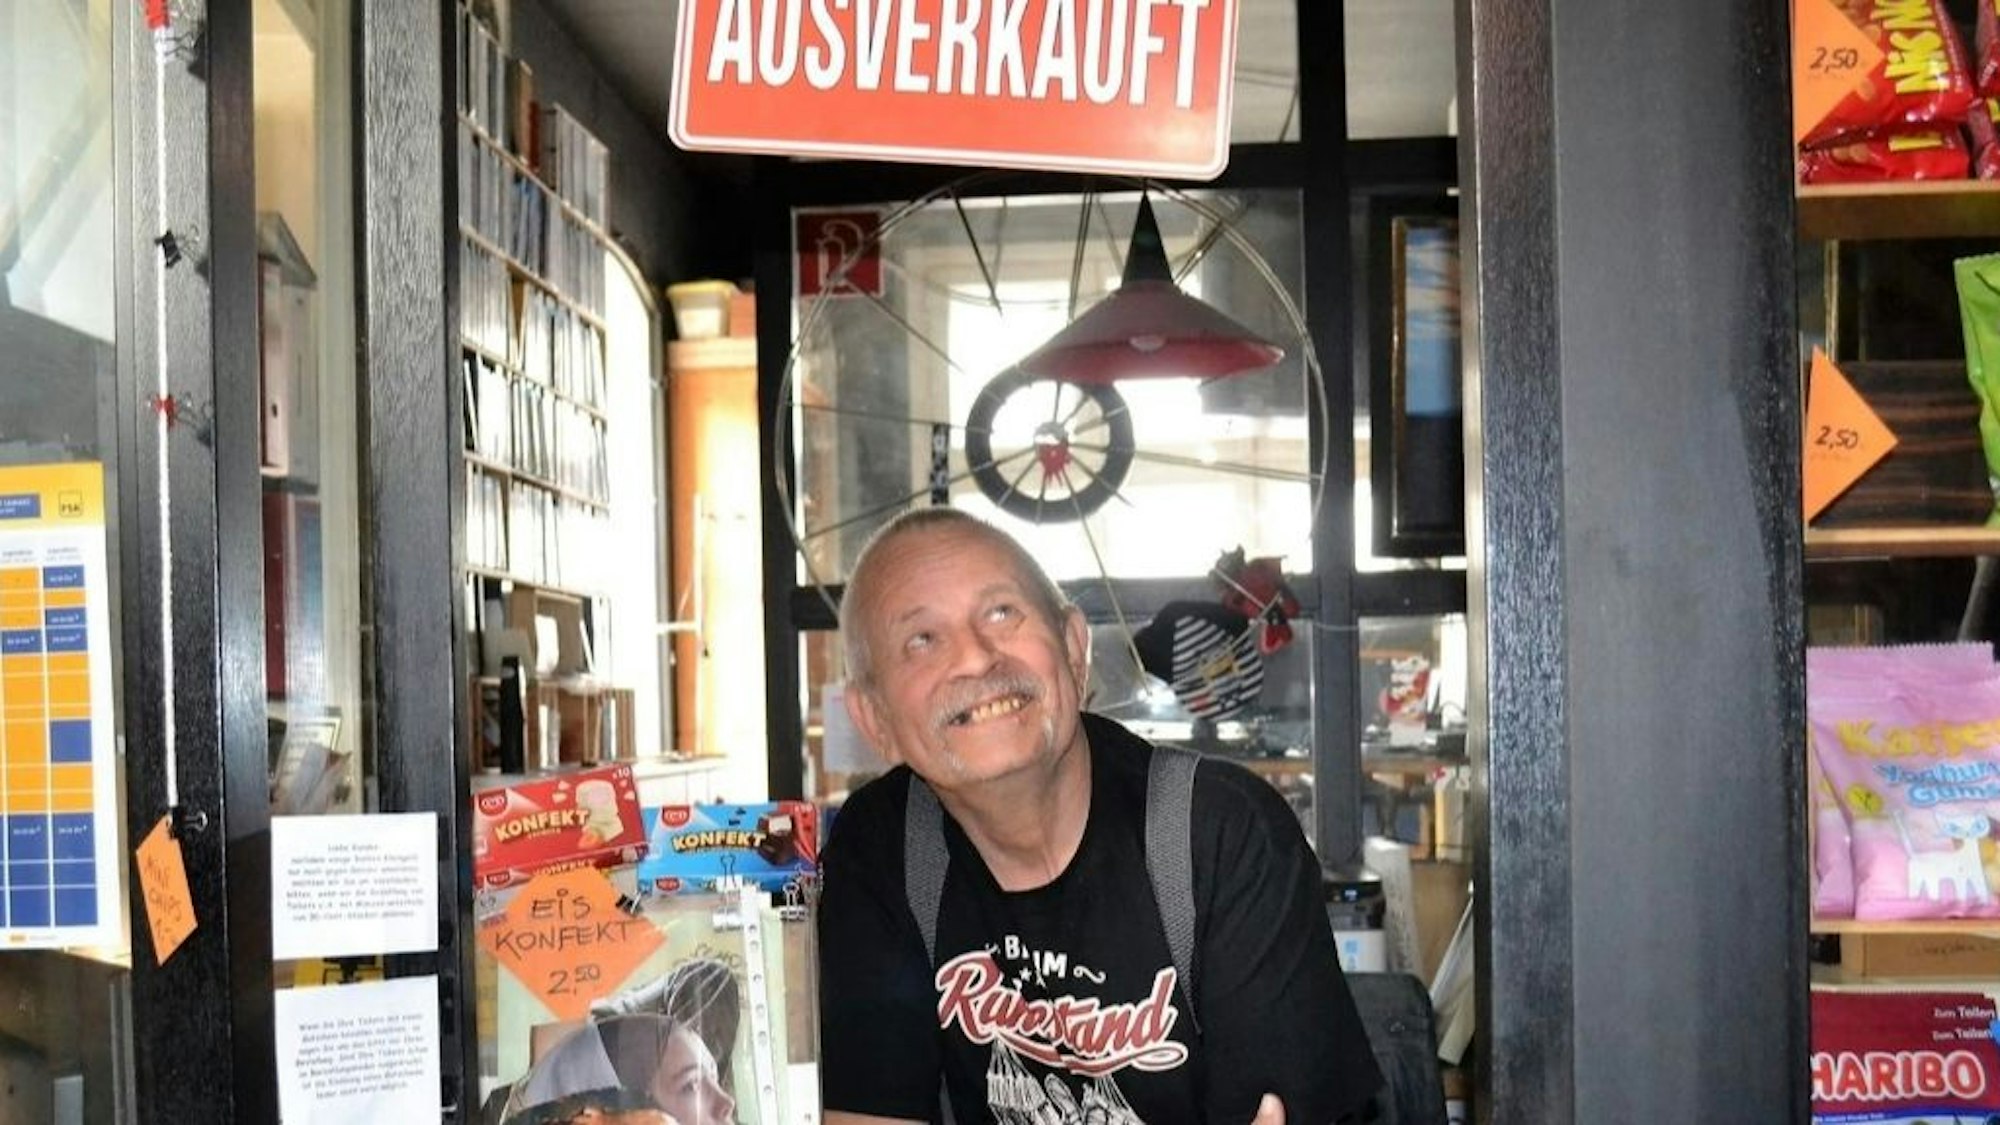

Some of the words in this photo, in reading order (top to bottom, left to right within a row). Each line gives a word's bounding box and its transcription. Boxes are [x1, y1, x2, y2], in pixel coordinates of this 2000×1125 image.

[706, 0, 1206, 109] AUSVERKAUFT
[1810, 46, 1858, 73] 2,50
[1815, 425, 1858, 449] 2,50
[494, 809, 589, 843] KONFEKT
[672, 831, 767, 853] KONFEKT
[494, 916, 630, 961] KONFEKT
[1811, 1050, 1986, 1101] HARIBO
